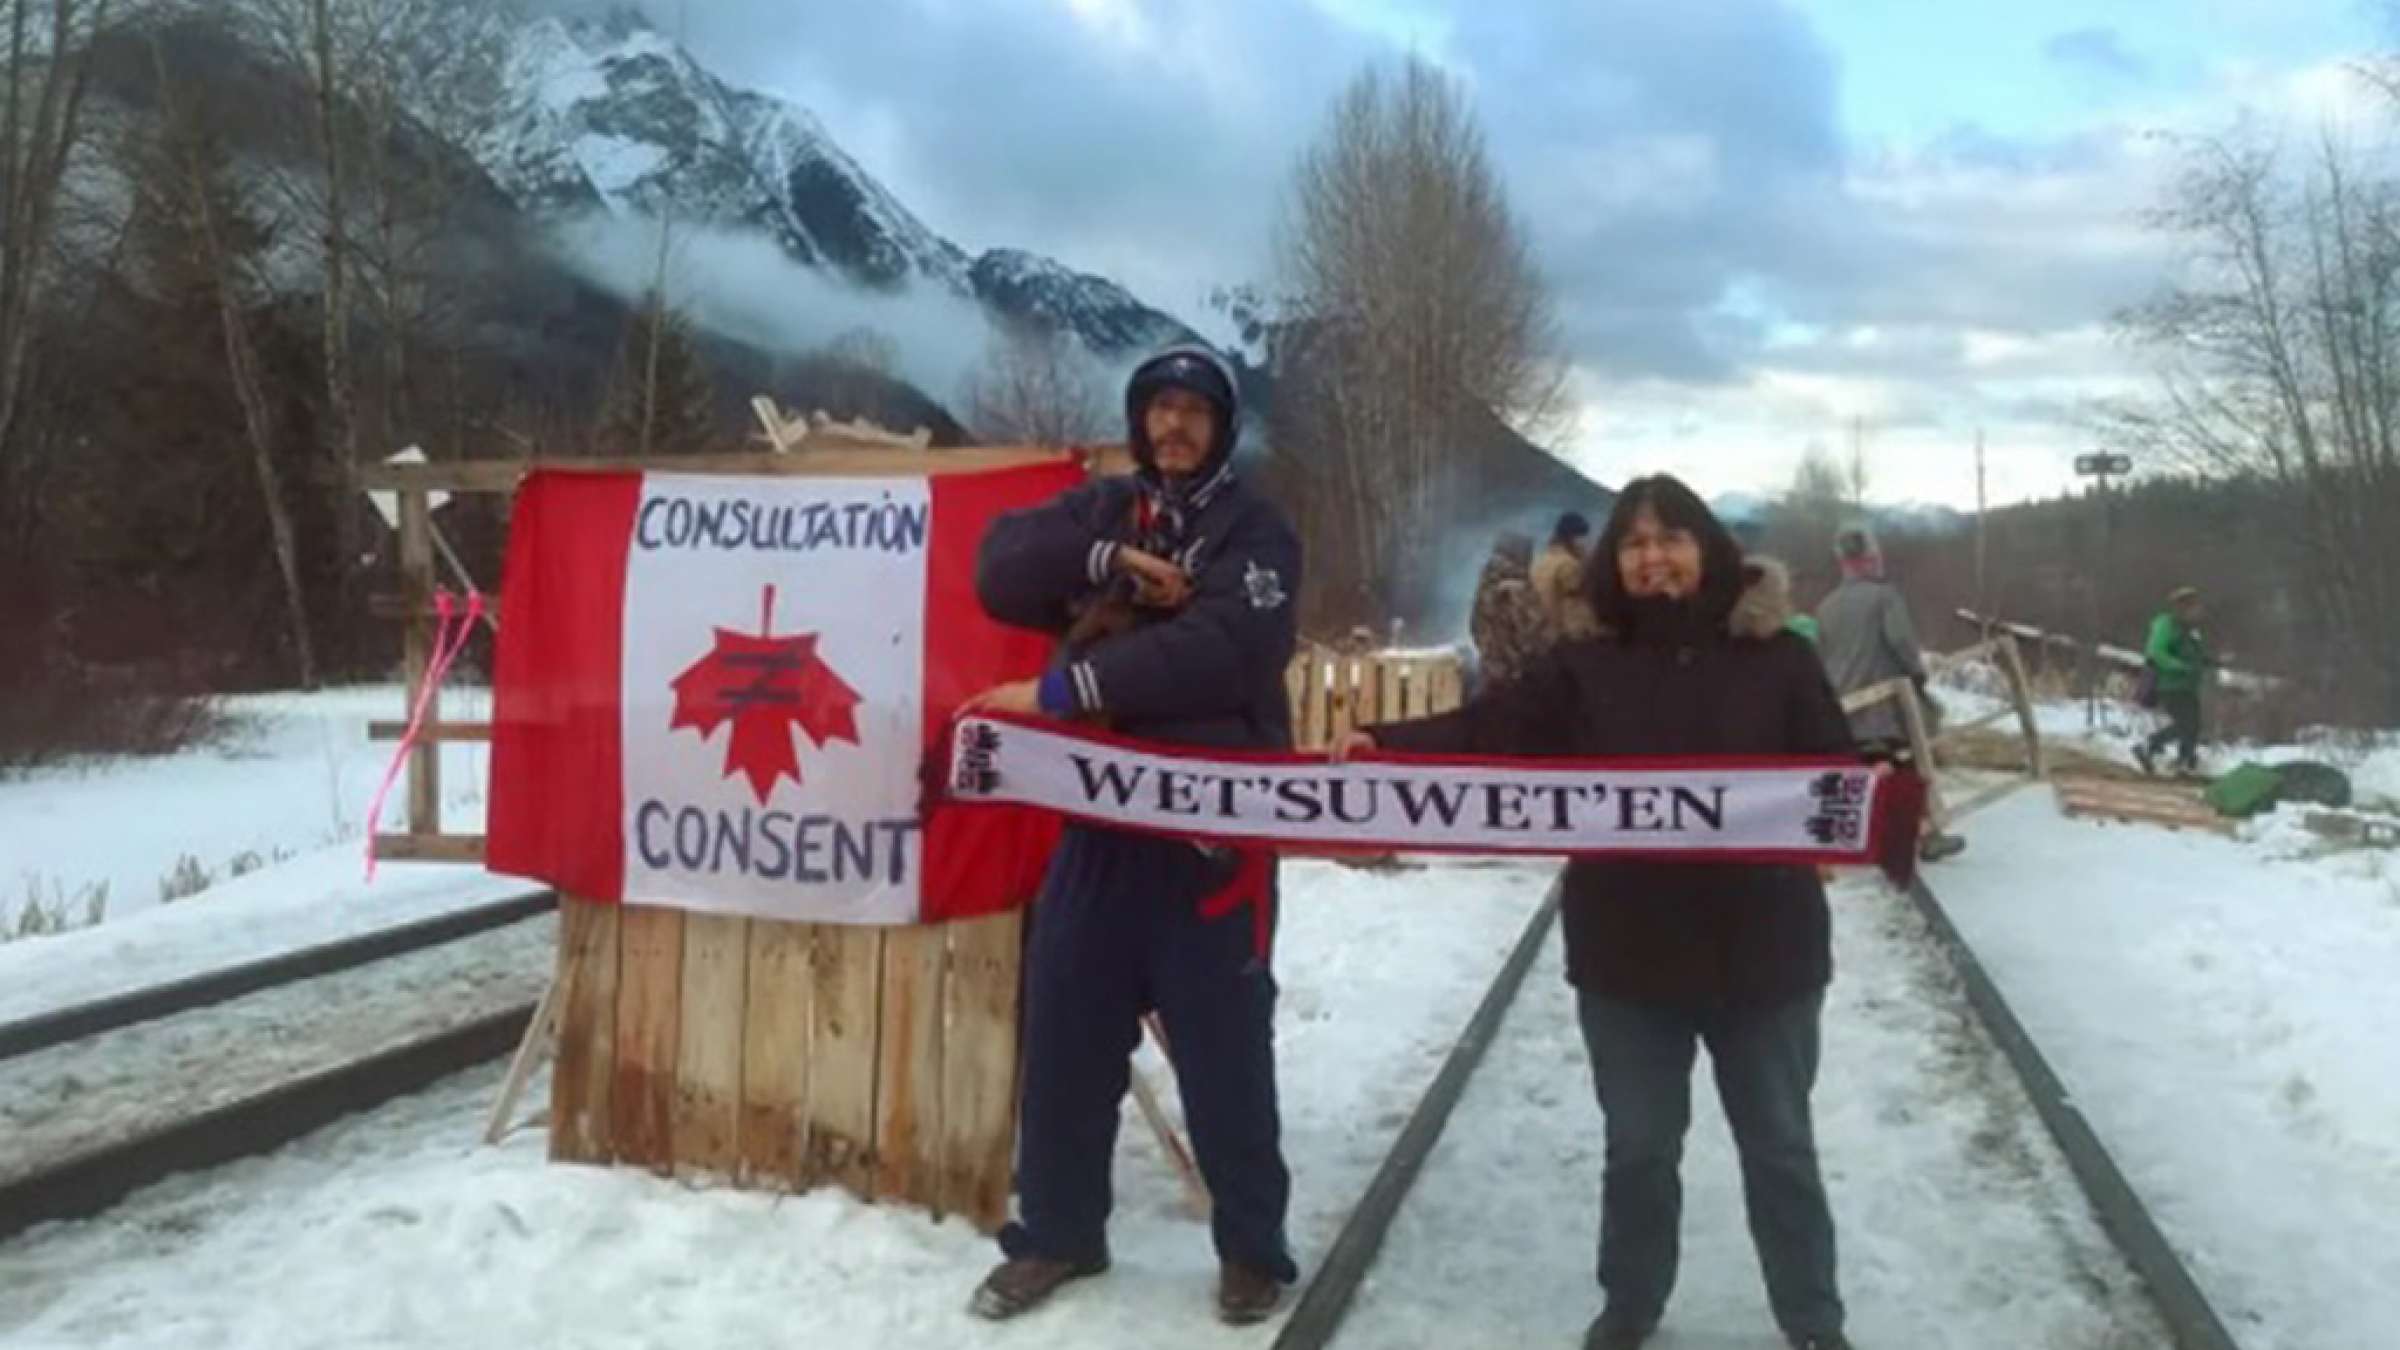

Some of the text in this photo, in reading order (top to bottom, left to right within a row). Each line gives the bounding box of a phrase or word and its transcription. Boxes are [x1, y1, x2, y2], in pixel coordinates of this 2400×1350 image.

[637, 494, 930, 554] CONSULTATION
[1069, 753, 1730, 832] WET'SUWET'EN
[635, 799, 922, 885] CONSENT
